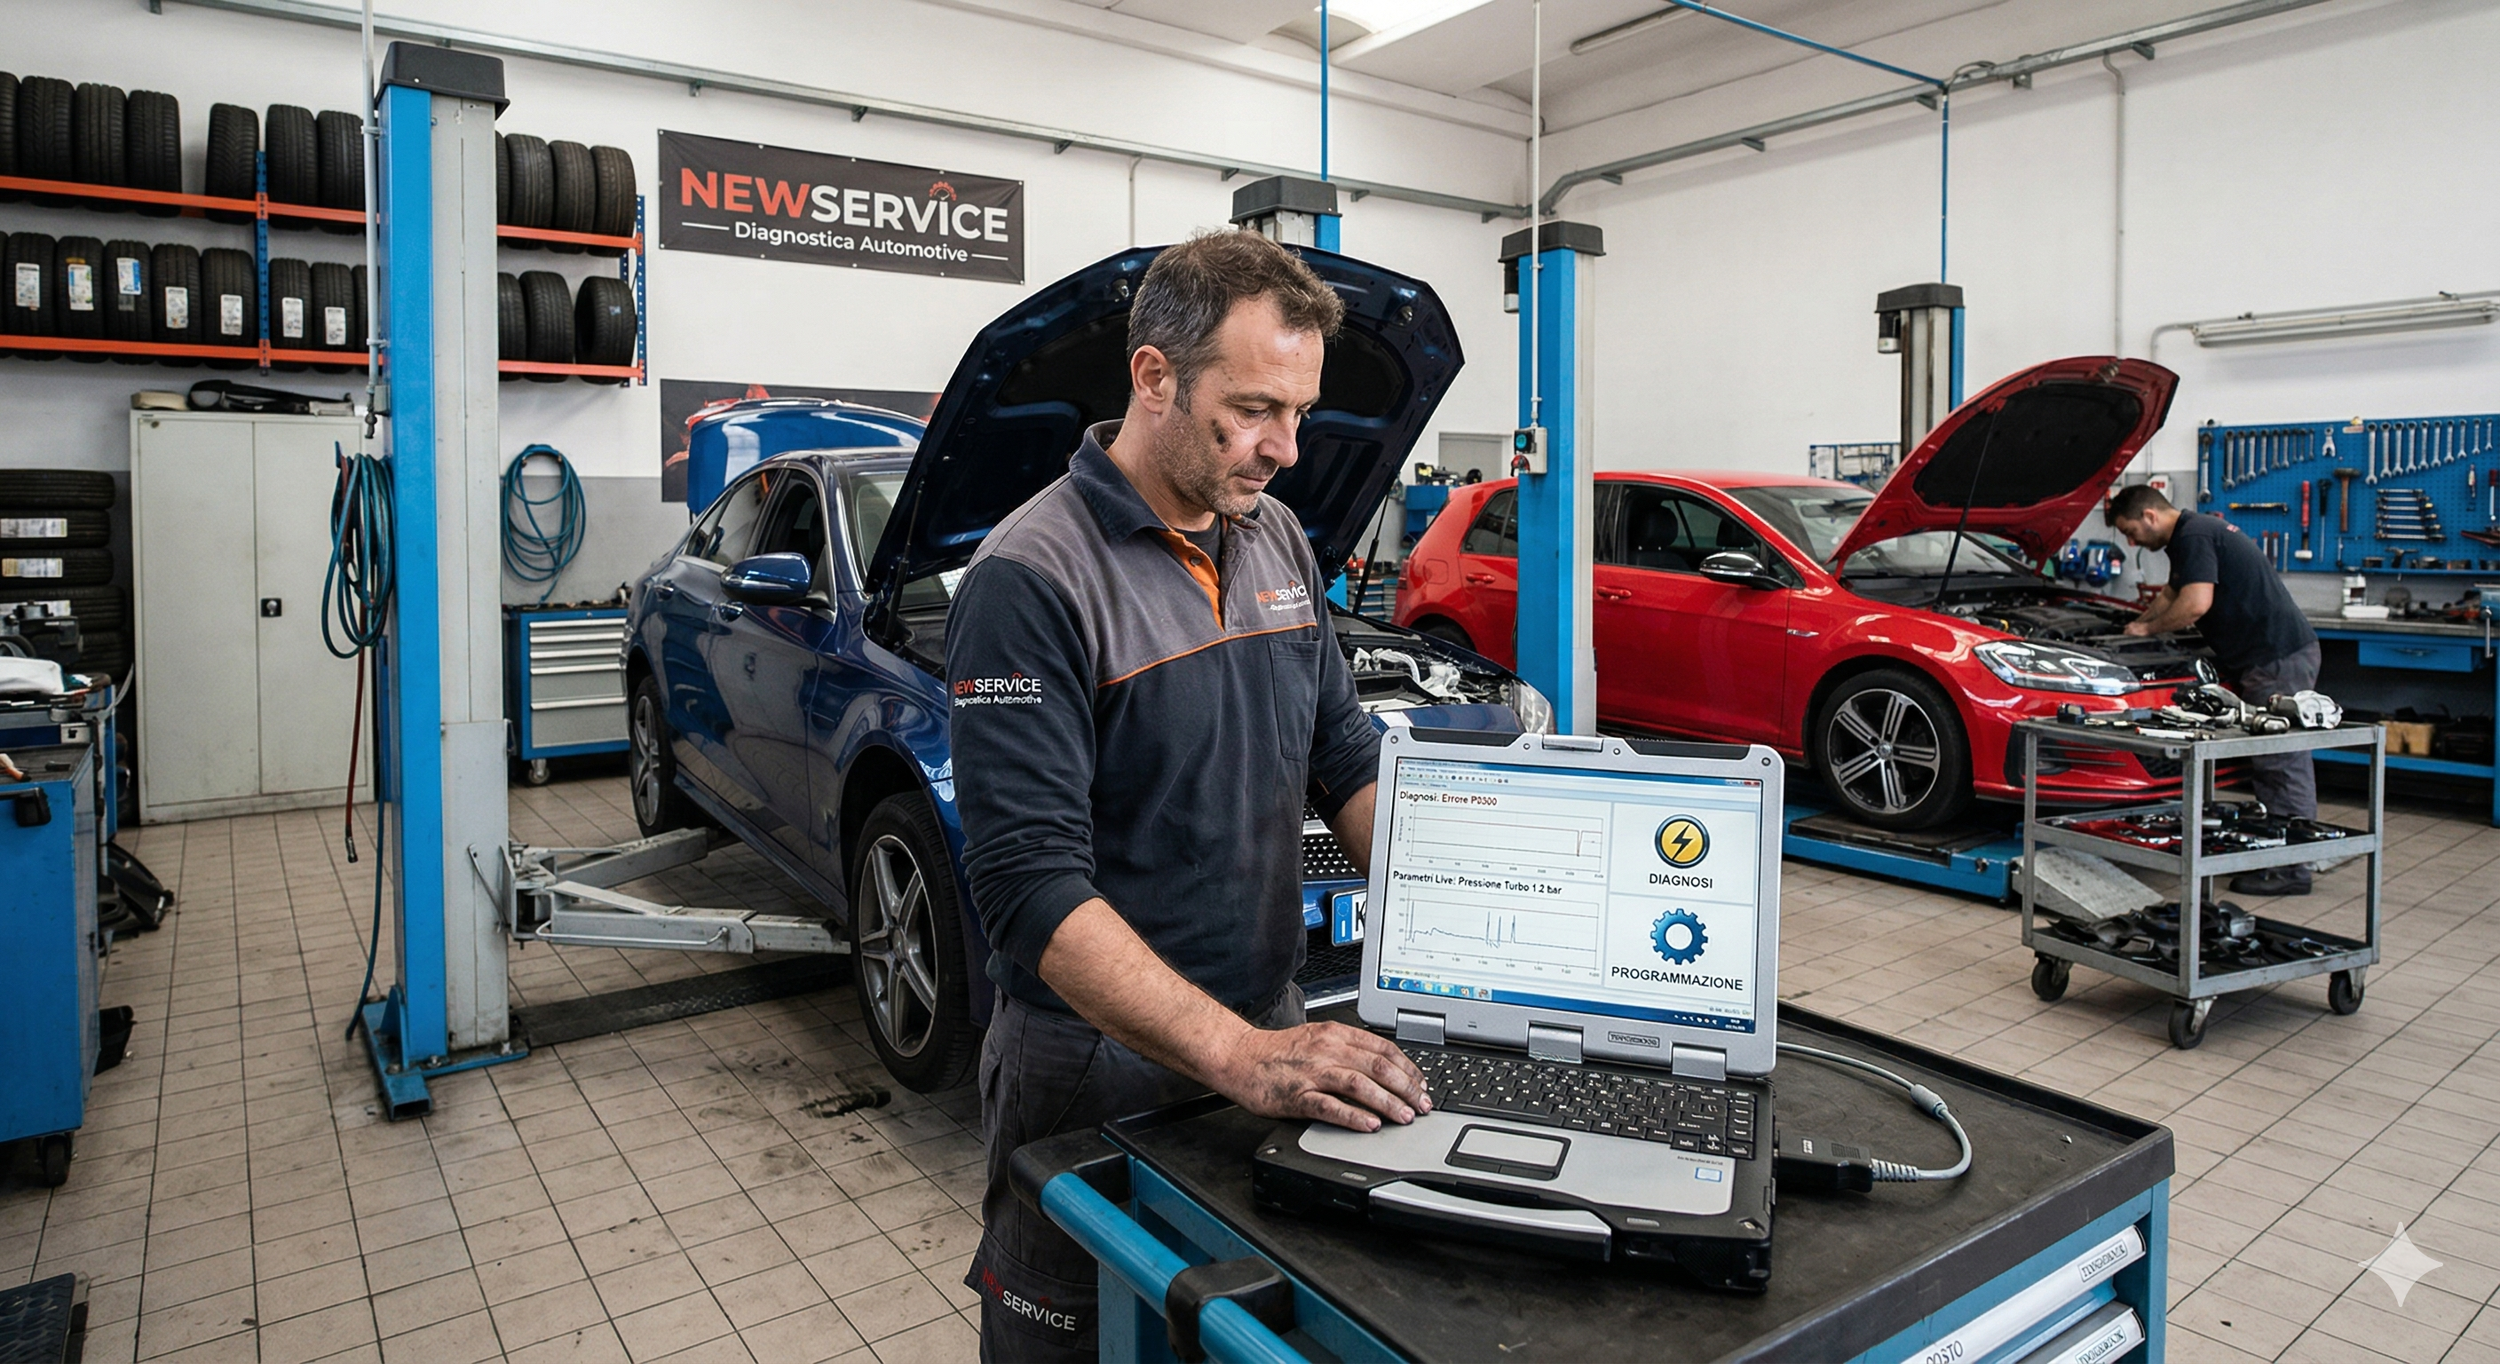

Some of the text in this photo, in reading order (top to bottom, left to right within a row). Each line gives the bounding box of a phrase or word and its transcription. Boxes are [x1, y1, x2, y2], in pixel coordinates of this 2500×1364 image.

[681, 167, 1010, 243] NEWSERVICE
[734, 221, 969, 262] Diagnostica Automotive
[1393, 870, 1433, 883] Parametri
[1458, 876, 1502, 889] Pressione
[1505, 880, 1529, 892] Turbo
[1649, 873, 1713, 889] DIAGNOSI
[1611, 966, 1744, 991] PROGRAMMAZIONE
